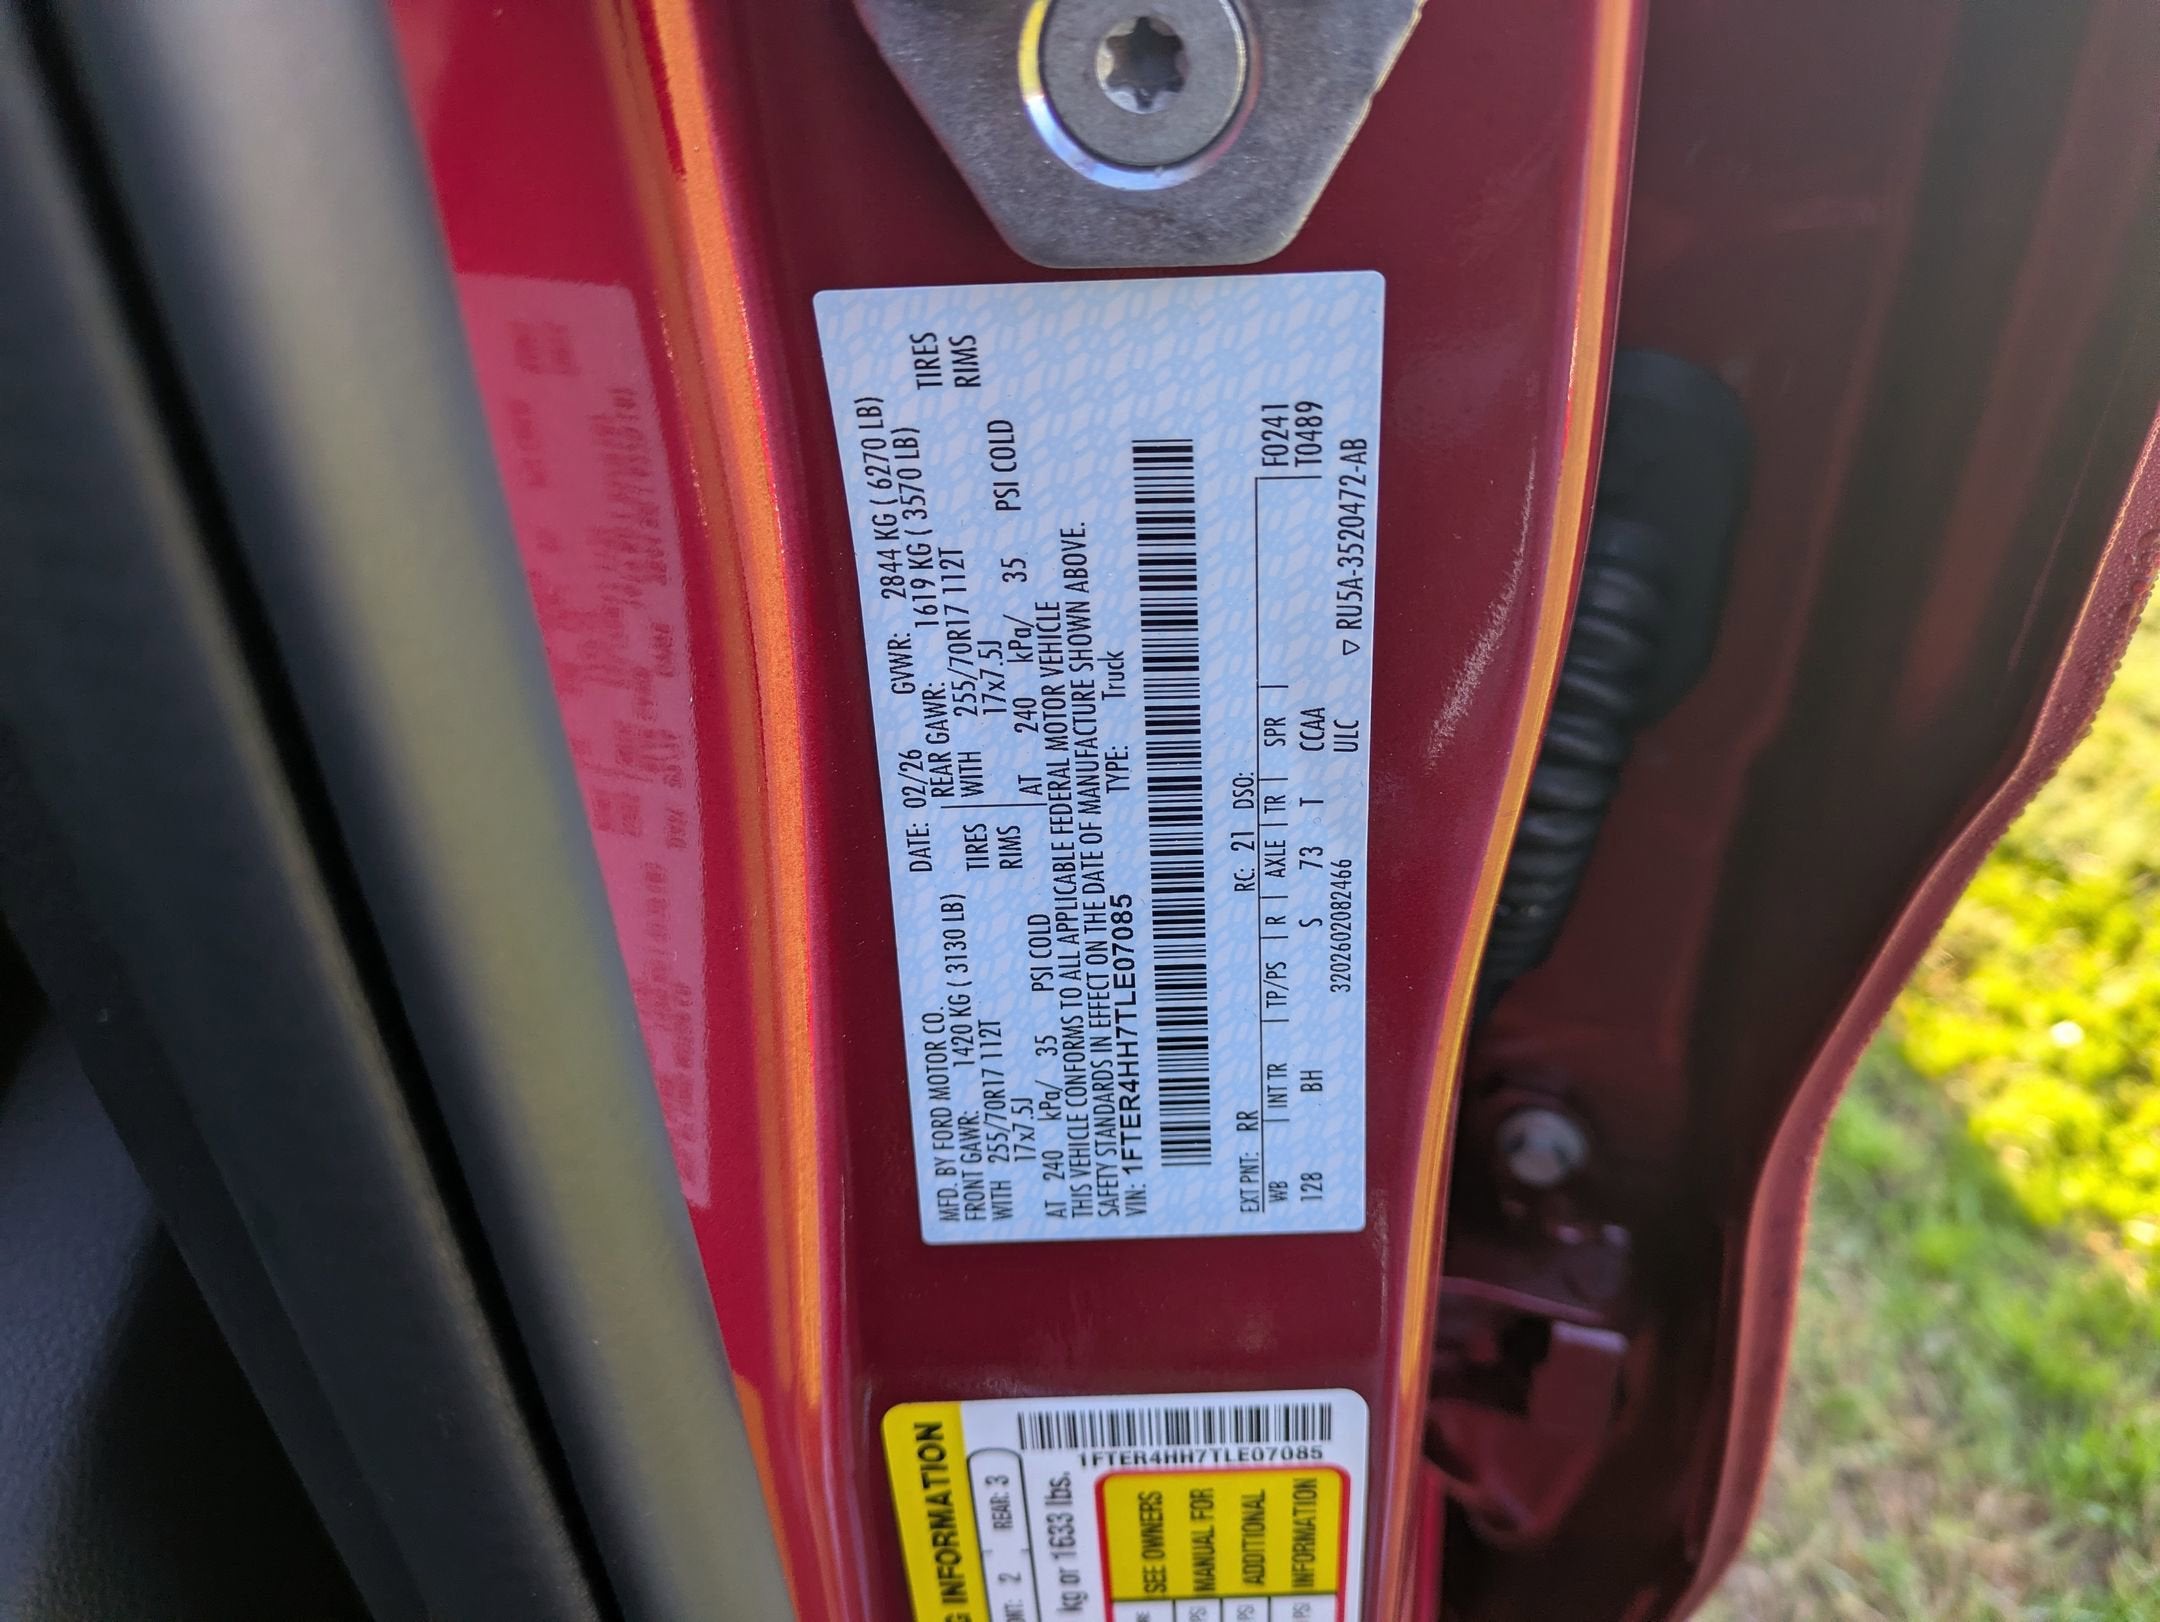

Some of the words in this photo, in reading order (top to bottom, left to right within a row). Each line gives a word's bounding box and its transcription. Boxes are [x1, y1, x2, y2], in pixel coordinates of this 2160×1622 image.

[909, 332, 943, 390] TIRES
[948, 335, 981, 387] RIMS
[854, 397, 884, 429] LB)
[1294, 401, 1323, 467] T0489
[890, 428, 920, 459] LB)
[987, 420, 1017, 472] COLD
[1261, 404, 1289, 466] F0241
[861, 438, 892, 489] 6270
[896, 468, 928, 520] 3570
[993, 482, 1021, 511] PSI
[871, 514, 899, 540] KG
[1336, 439, 1367, 629] RU5A-3520472-AB
[876, 549, 906, 599] 2844
[906, 543, 933, 569] KG
[938, 547, 967, 594] 112T
[1000, 558, 1027, 583] 35
[1060, 522, 1089, 593] ABOVE.
[910, 578, 939, 628] 1619
[1002, 614, 1035, 662] kPa/
[1034, 602, 1064, 678] VEHICLE
[1065, 601, 1094, 672] SHOWN
[887, 633, 916, 694] GVWR:
[941, 604, 978, 716] 255/70R17
[977, 641, 1007, 715] 17x7.5J
[1097, 651, 1126, 701] Truck
[922, 682, 950, 744] GAWR:
[1012, 698, 1038, 733] 240
[1041, 684, 1069, 751] MOTOR
[1264, 717, 1286, 747] SPR
[1299, 707, 1325, 751] CCAA
[1070, 679, 1101, 814] MANUFACTURE
[1333, 719, 1359, 752] ULC
[897, 749, 928, 808] 02/26
[928, 752, 955, 797] REAR
[957, 751, 984, 797] WITH
[1017, 774, 1043, 795] AT
[1105, 746, 1130, 794] TYPE:
[1232, 772, 1254, 809] DSO:
[1046, 758, 1074, 834] FEDERAL
[1264, 795, 1286, 814] TR
[1299, 797, 1324, 807] T
[906, 823, 933, 872] DATE:
[962, 823, 990, 872] TIRES
[996, 826, 1023, 869] RIMS
[1079, 822, 1103, 844] OF
[1230, 832, 1255, 851] 21
[1080, 851, 1105, 894] DATE
[1264, 840, 1286, 878] AXLE
[1299, 846, 1323, 870] 73
[1051, 842, 1079, 945] APPLICABLE
[1233, 868, 1255, 892] RC:
[939, 894, 966, 921] LB)
[1083, 902, 1107, 934] THE
[1265, 915, 1286, 925] R
[1298, 918, 1323, 927] S
[1330, 859, 1352, 992] 3202602082466
[942, 929, 968, 973] 3130
[1027, 914, 1052, 958] COLD
[1085, 941, 1108, 965] ON
[1030, 967, 1054, 991] PSI
[1058, 951, 1081, 981] ALL
[1263, 962, 1289, 1008] TP/PS
[947, 994, 971, 1017] KG
[1059, 988, 1083, 1010] TO
[1086, 972, 1111, 1028] EFFECT
[921, 1007, 945, 1034] CO.
[978, 1019, 1003, 1060] 112T
[1110, 894, 1143, 1175] 1FTER4HH7TLE07085
[950, 1024, 975, 1067] 1420
[1034, 1035, 1058, 1056] 35
[1060, 1015, 1087, 1107] CONFORMS
[1090, 1037, 1112, 1052] IN
[924, 1041, 951, 1100] MOTOR
[1267, 1063, 1287, 1080] TR
[1300, 1070, 1323, 1092] BH
[981, 1068, 1010, 1163] 255/70R17
[1035, 1080, 1063, 1121] kPa/
[1090, 1060, 1117, 1156] STANDARDS
[1267, 1085, 1287, 1108] INT
[930, 1107, 954, 1150] FORD
[958, 1111, 982, 1163] GAWR:
[1010, 1098, 1036, 1162] 17x7.5J
[1236, 1110, 1258, 1131] RR
[934, 1157, 957, 1176] BY
[1041, 1150, 1065, 1181] 240
[1066, 1114, 1091, 1178] VEHICLE
[1239, 1152, 1259, 1183] PNT:
[1300, 1172, 1323, 1201] 128
[937, 1183, 959, 1221] MFD.
[962, 1170, 986, 1220] FRONT
[990, 1181, 1013, 1220] WITH
[1044, 1200, 1067, 1218] AT
[1070, 1184, 1093, 1218] THIS
[1096, 1162, 1120, 1217] SAFETY
[1125, 1184, 1147, 1216] VIN:
[1240, 1188, 1260, 1213] EXT
[1268, 1181, 1288, 1202] WB
[1079, 1445, 1323, 1468] 1FTER4HH7TLE07085
[985, 1475, 1009, 1487] 3
[1044, 1471, 1072, 1505] lbs.
[914, 1421, 967, 1605] INFORMATION
[990, 1492, 1013, 1529] REAR:
[1189, 1488, 1214, 1520] FOR
[1046, 1512, 1076, 1560] 1633
[1138, 1491, 1165, 1560] OWNERS
[1241, 1489, 1266, 1586] ADDITIONAL
[1291, 1477, 1317, 1588] INFORMATION
[998, 1573, 1021, 1584] 2
[1058, 1566, 1080, 1585] or
[1142, 1565, 1167, 1593] SEE
[1190, 1526, 1216, 1592] MANUAL
[1056, 1592, 1087, 1612] kg
